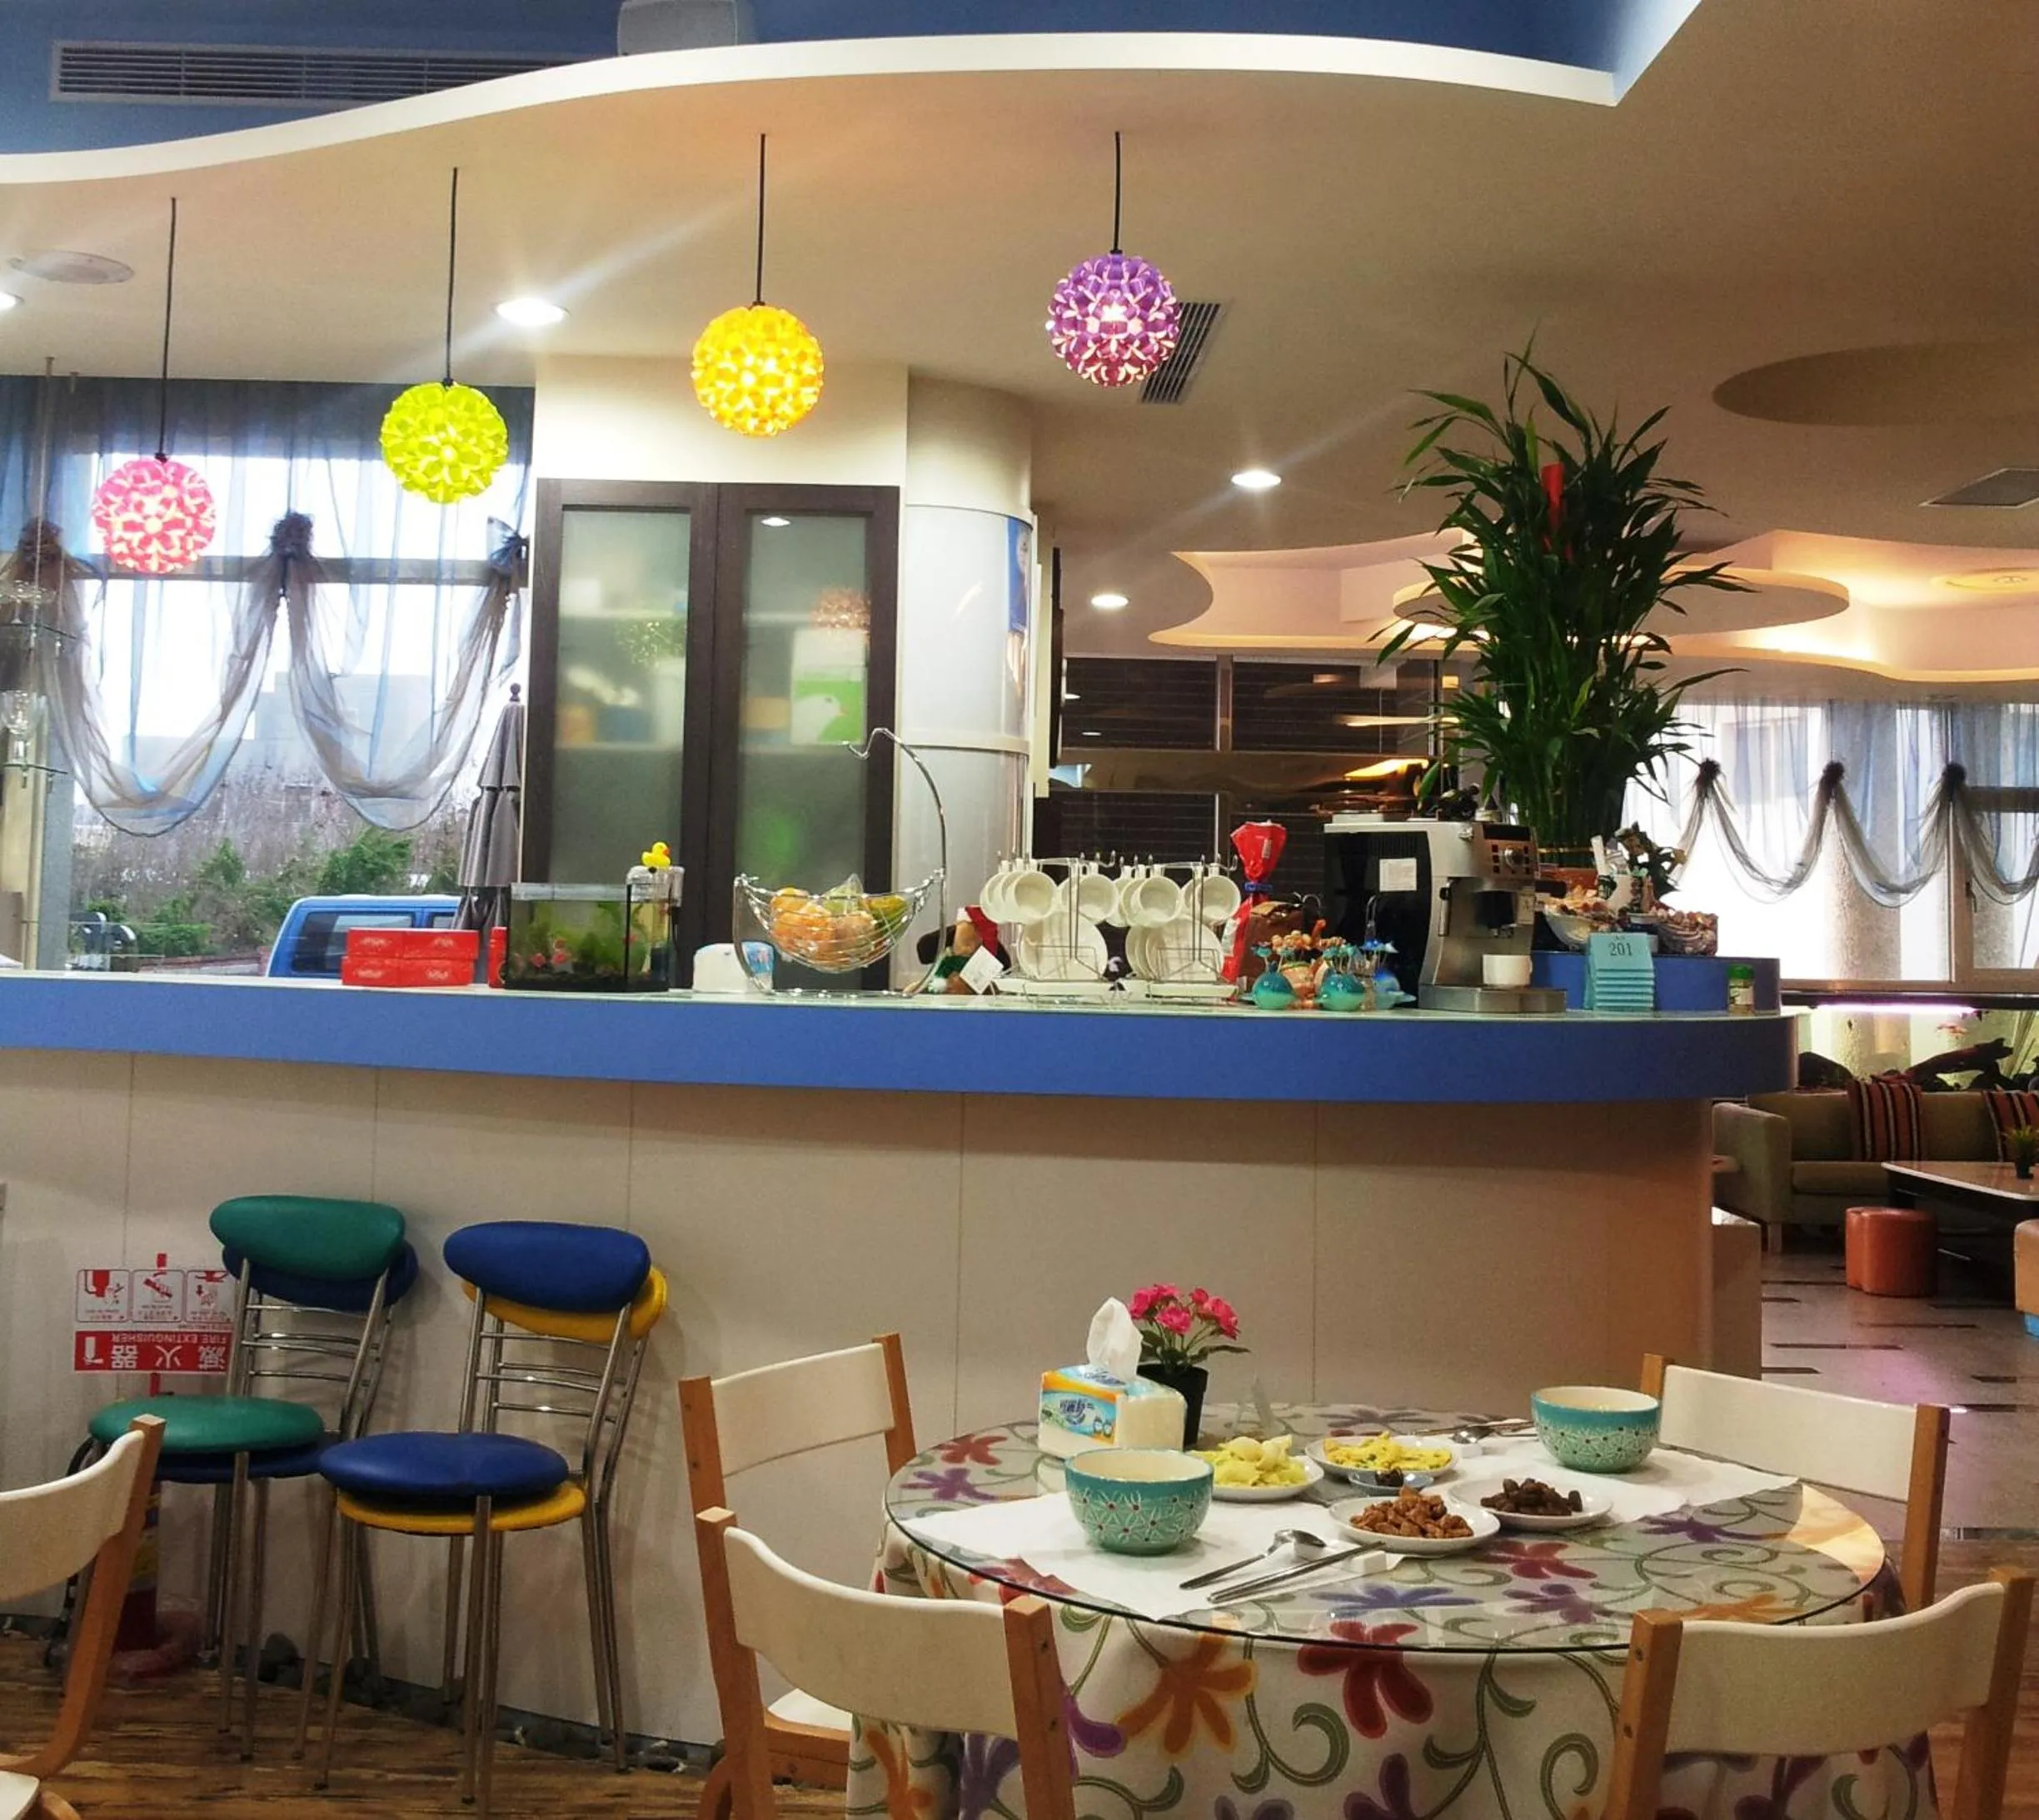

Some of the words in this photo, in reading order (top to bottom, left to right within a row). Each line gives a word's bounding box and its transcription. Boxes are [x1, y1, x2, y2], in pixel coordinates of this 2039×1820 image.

[1608, 942, 1633, 956] 201
[112, 1333, 198, 1344] EXTINGUISHER
[202, 1334, 227, 1344] FIRE
[111, 1344, 226, 1369] 滅火器
